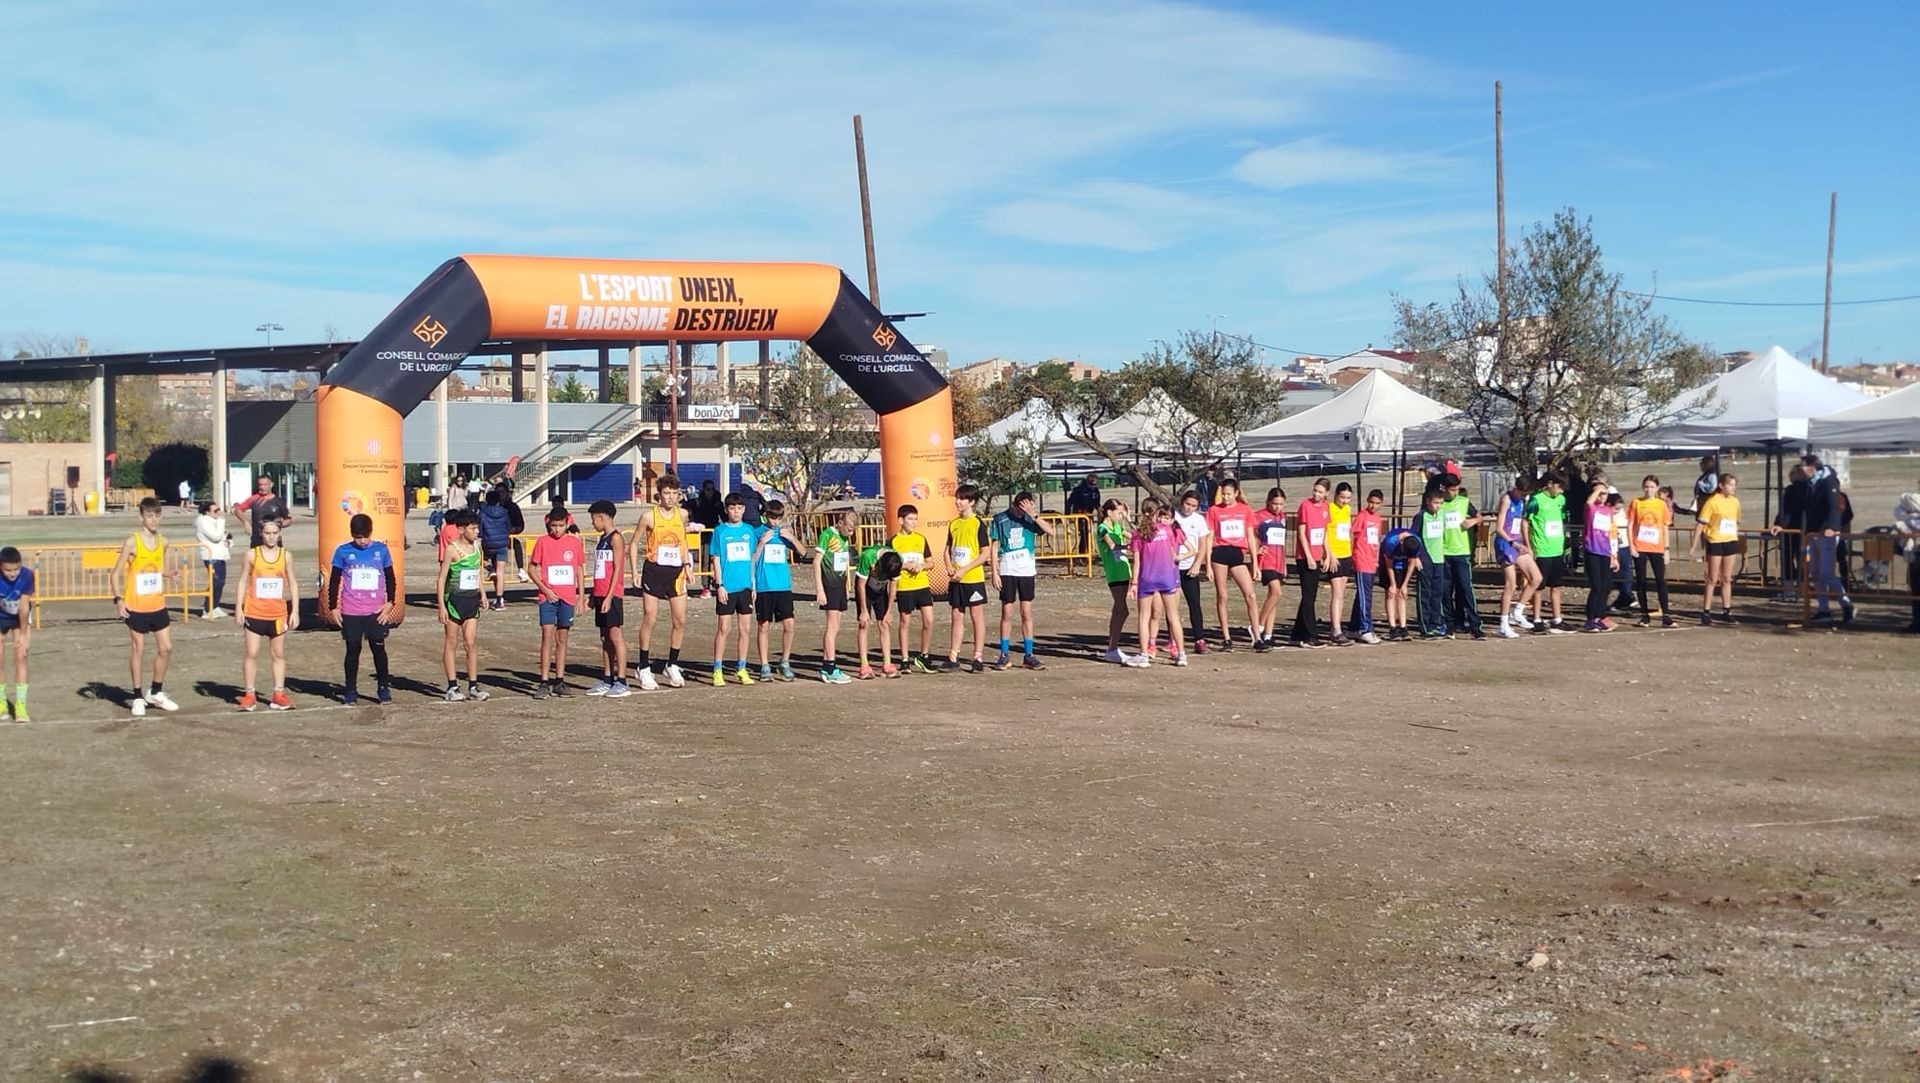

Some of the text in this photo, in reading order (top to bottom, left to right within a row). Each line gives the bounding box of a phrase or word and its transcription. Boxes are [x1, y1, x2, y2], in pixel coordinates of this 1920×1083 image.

[579, 273, 744, 305] L'ESPORT UNEIX,
[545, 304, 779, 331] EL RACISME DESTRUEIX
[376, 351, 425, 360] CONSELL
[839, 354, 882, 363] CONSELL
[399, 362, 452, 372] DE L'URGELL
[858, 364, 914, 373] DE L'URGELL
